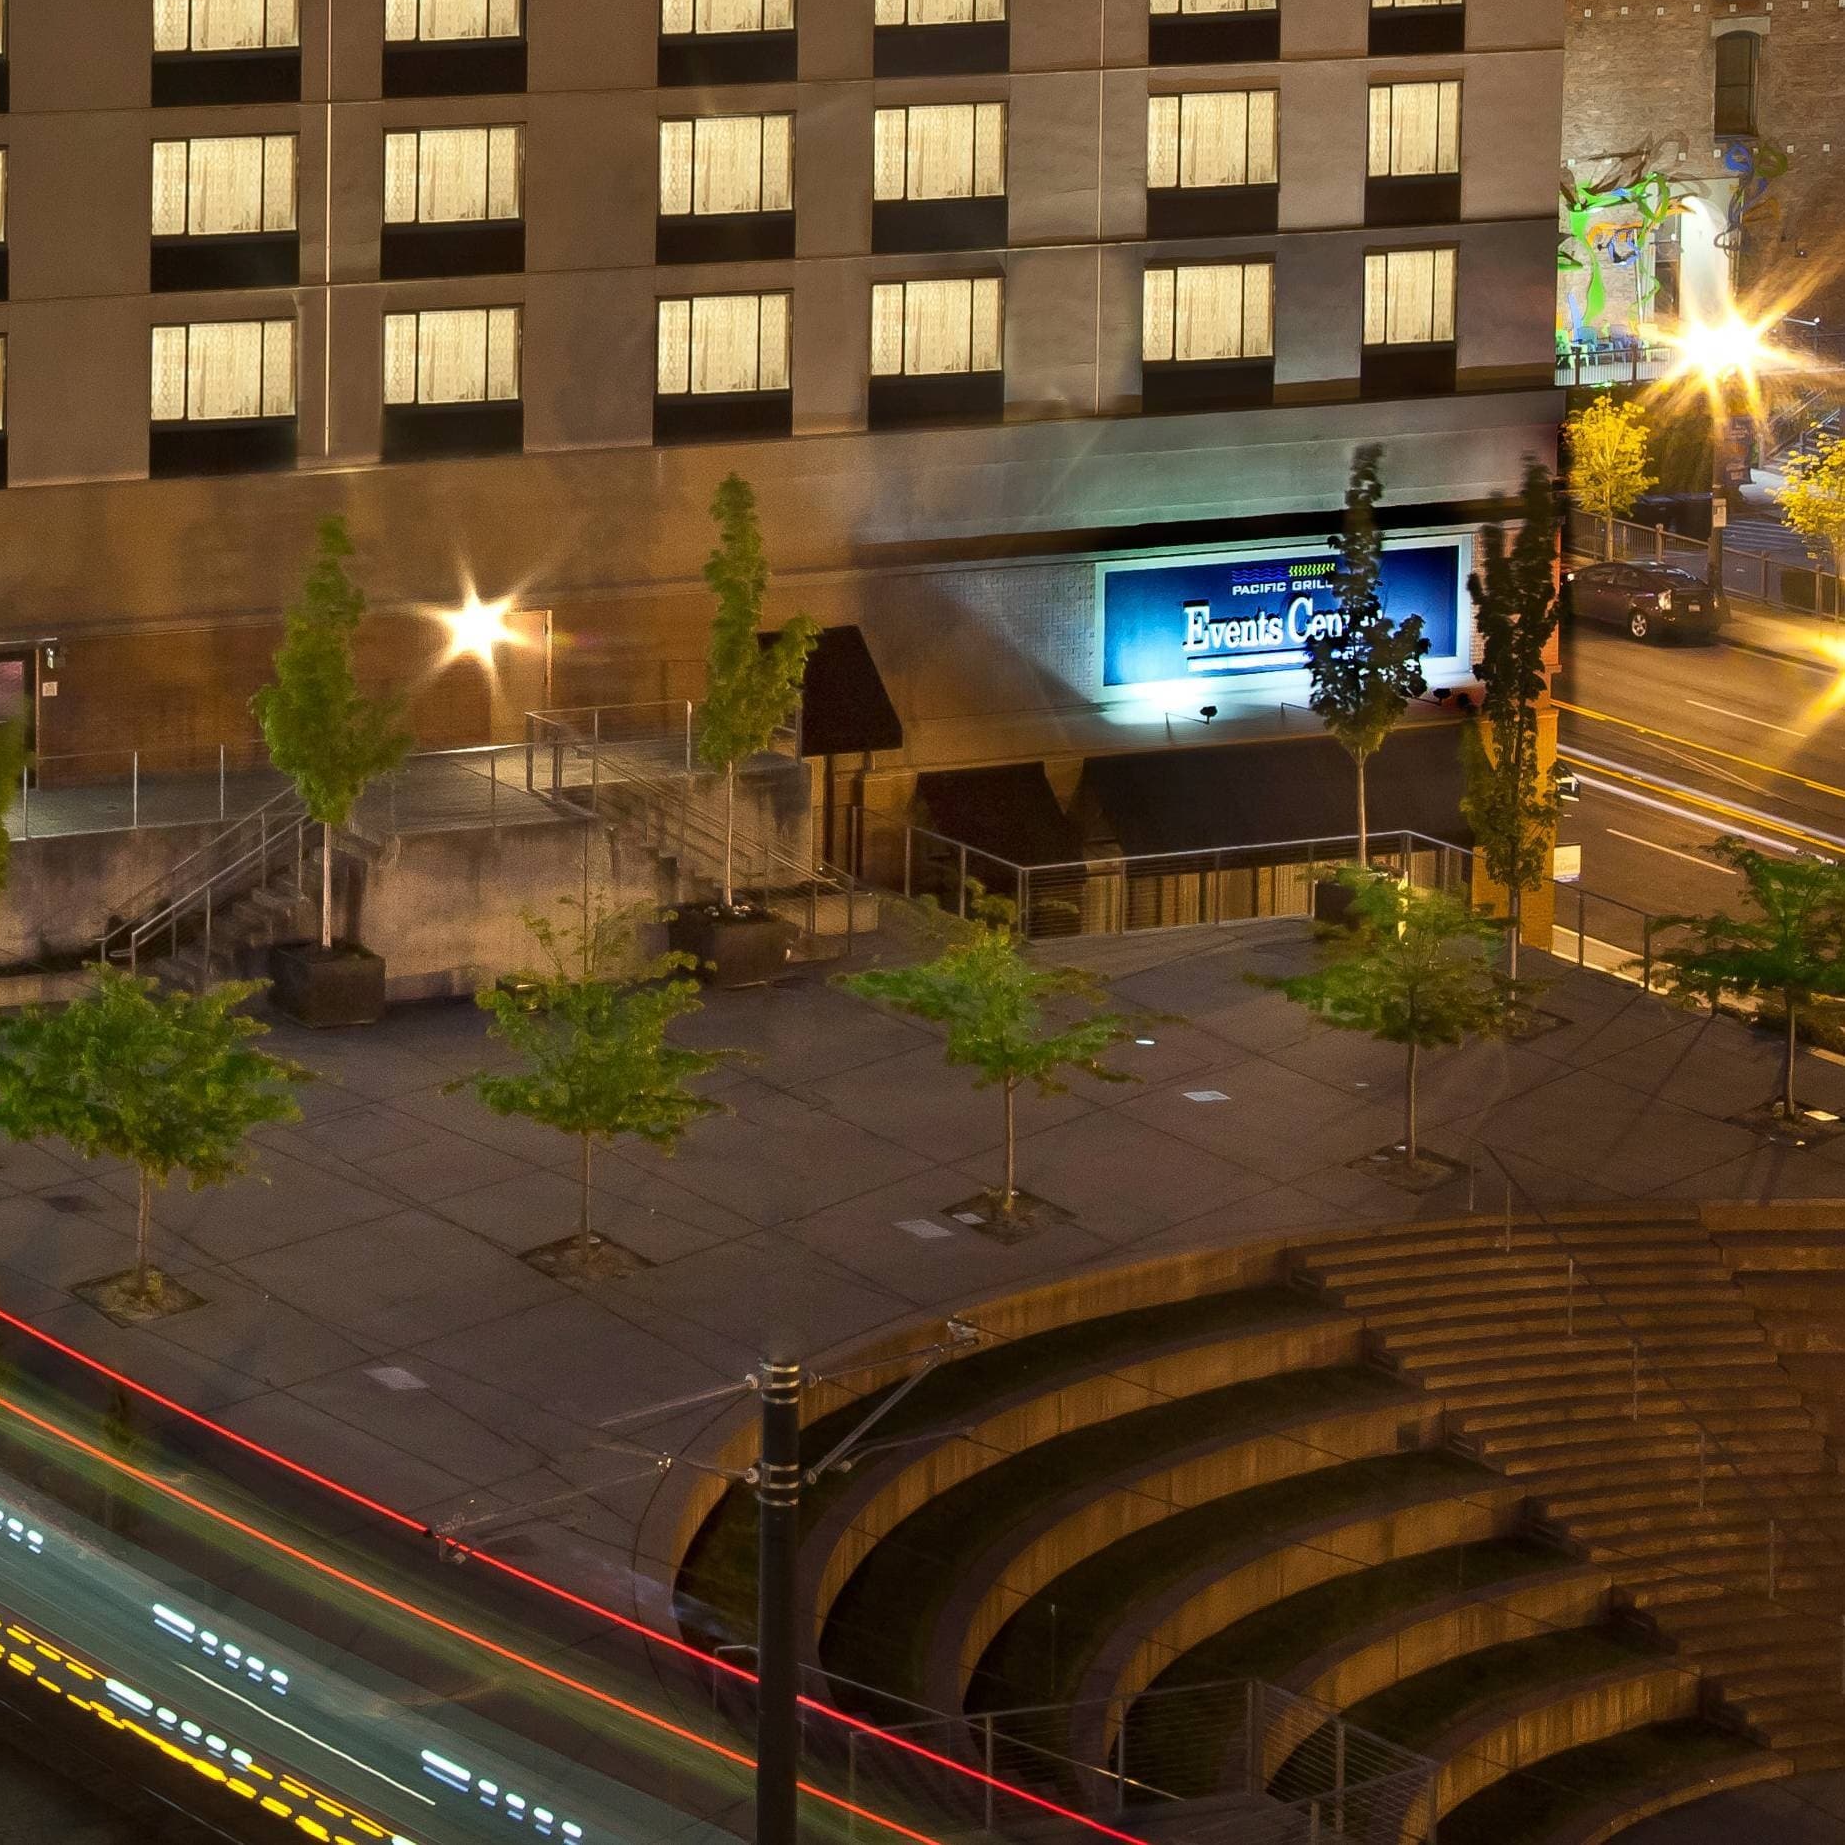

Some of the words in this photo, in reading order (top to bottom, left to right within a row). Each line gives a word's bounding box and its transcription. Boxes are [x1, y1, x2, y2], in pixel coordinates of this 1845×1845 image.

[1232, 581, 1287, 596] PACIFIC
[1292, 579, 1334, 591] GRILL
[1182, 605, 1283, 652] Events
